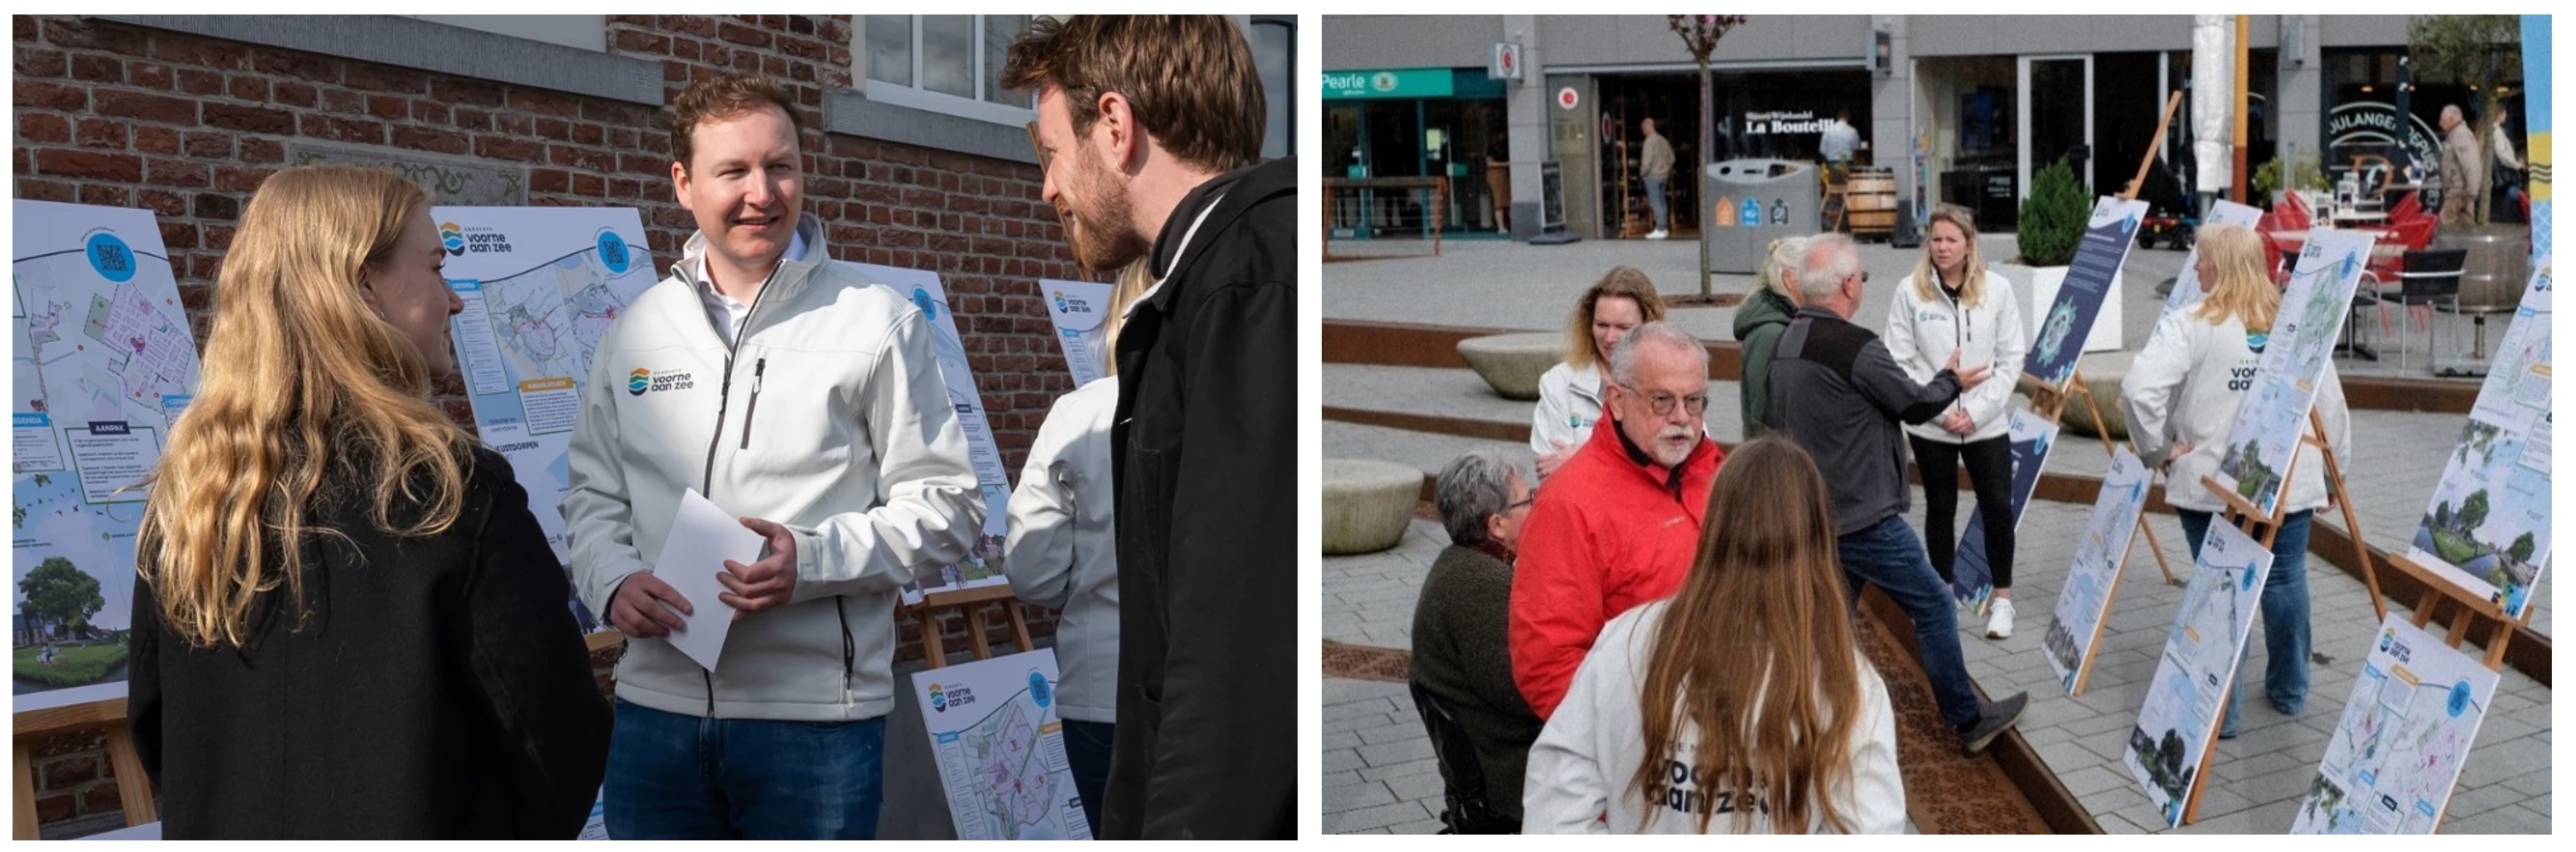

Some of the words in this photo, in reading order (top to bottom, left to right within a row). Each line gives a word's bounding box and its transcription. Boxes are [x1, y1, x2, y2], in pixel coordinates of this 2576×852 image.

[1322, 73, 1365, 89] Pearle
[1746, 121, 1766, 133] La
[1771, 118, 1835, 133] Bouteill
[466, 233, 506, 242] voorne
[469, 243, 491, 252] aan
[492, 243, 512, 252] zee
[653, 373, 691, 383] voorne
[651, 383, 672, 391] aan
[674, 381, 694, 390] zee
[2228, 380, 2253, 390] aa
[95, 424, 126, 433] AANPAK
[495, 440, 539, 453] KUSTDORPEN
